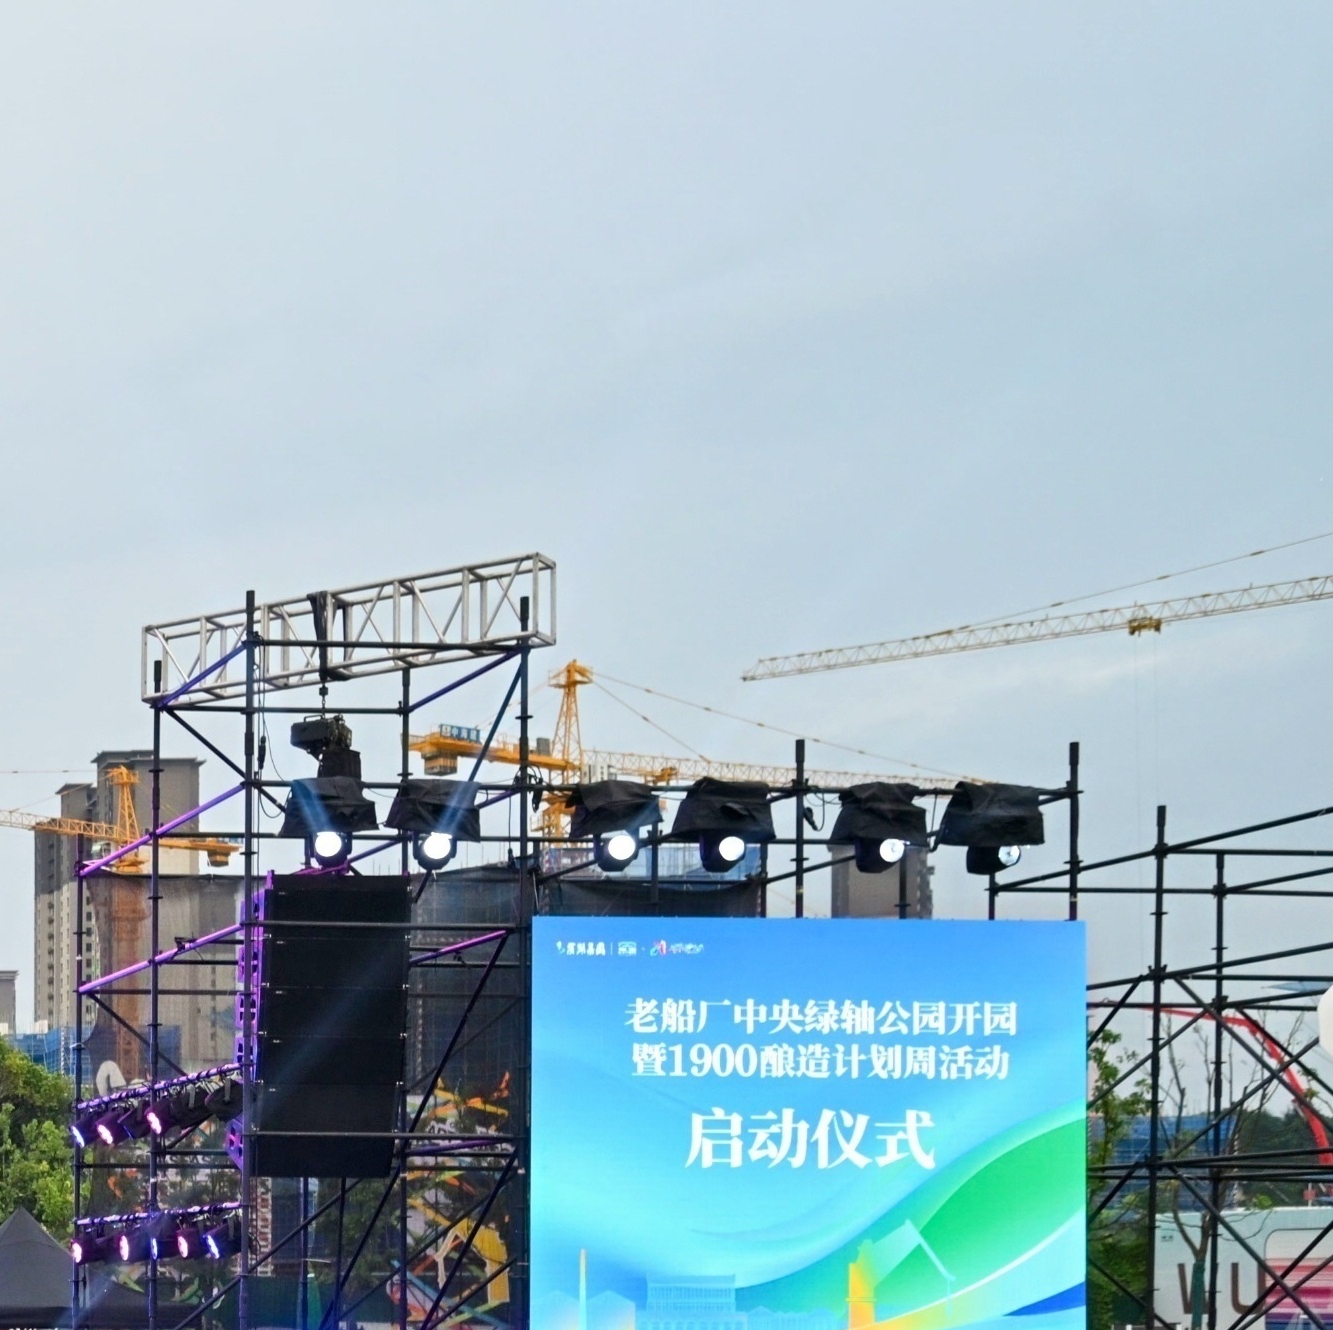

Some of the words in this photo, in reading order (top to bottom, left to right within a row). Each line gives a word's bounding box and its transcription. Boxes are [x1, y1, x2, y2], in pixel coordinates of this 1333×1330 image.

[624, 997, 1017, 1037] 老船厂中央绿轴公园开园
[631, 1043, 1010, 1080] 暨1900酿造计划周活动
[685, 1107, 936, 1170] 启动仪式
